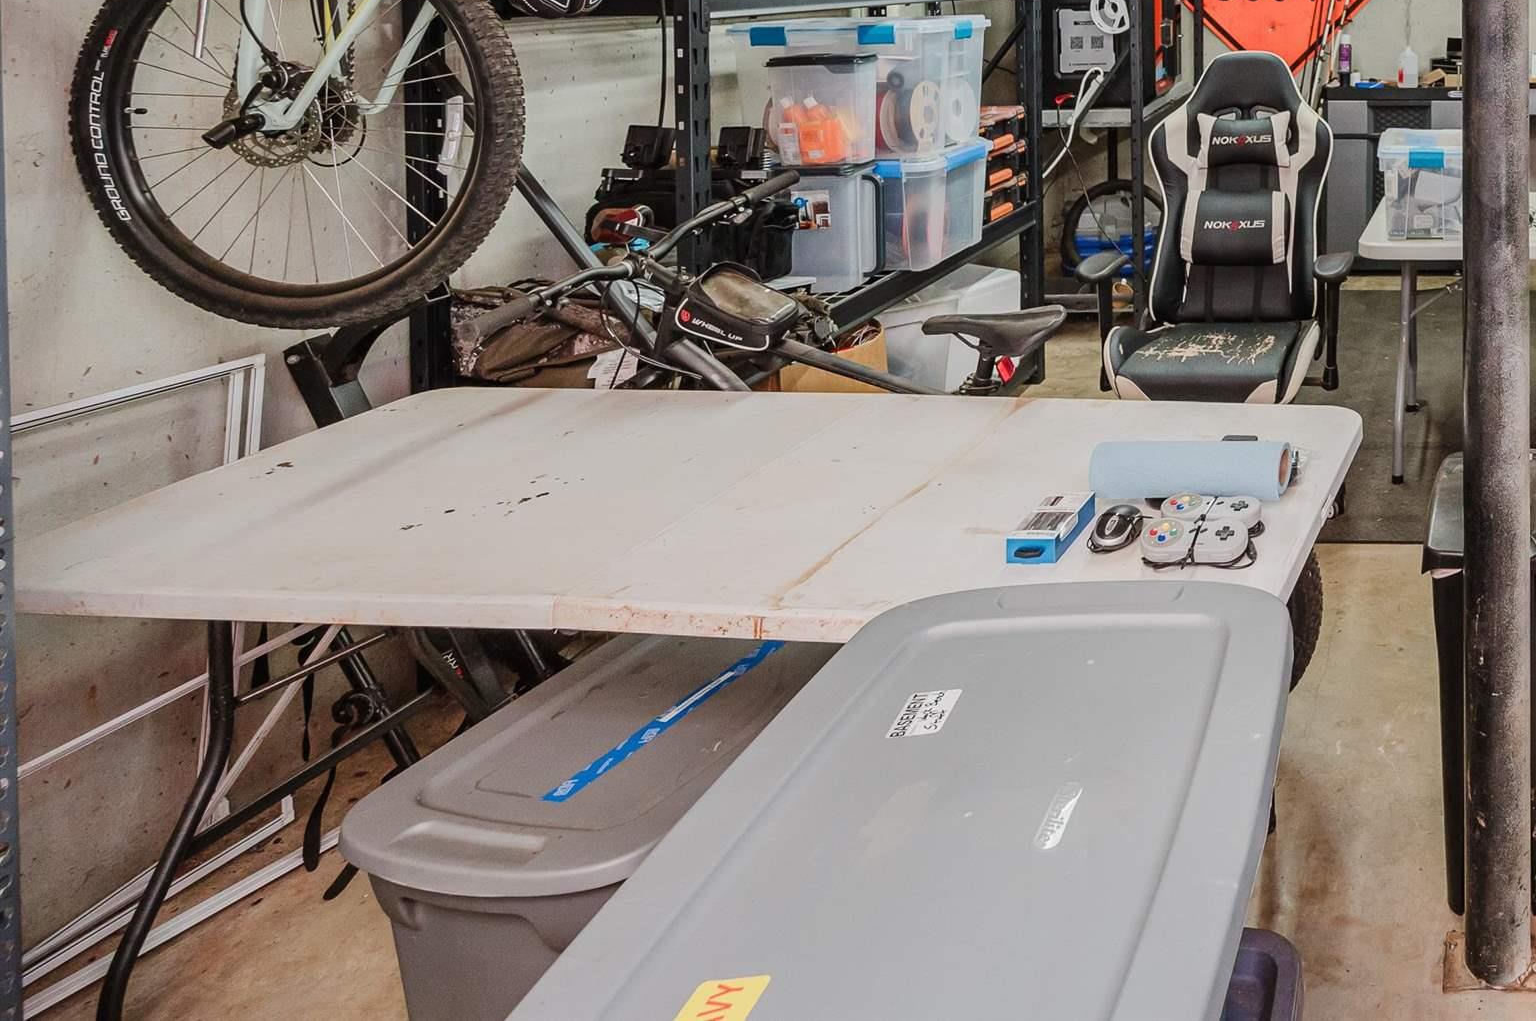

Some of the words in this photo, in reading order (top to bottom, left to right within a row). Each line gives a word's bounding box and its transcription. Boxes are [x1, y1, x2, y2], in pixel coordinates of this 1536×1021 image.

[88, 71, 105, 150] CONTROL
[94, 152, 132, 222] GROUND
[889, 693, 928, 738] BASEMENT
